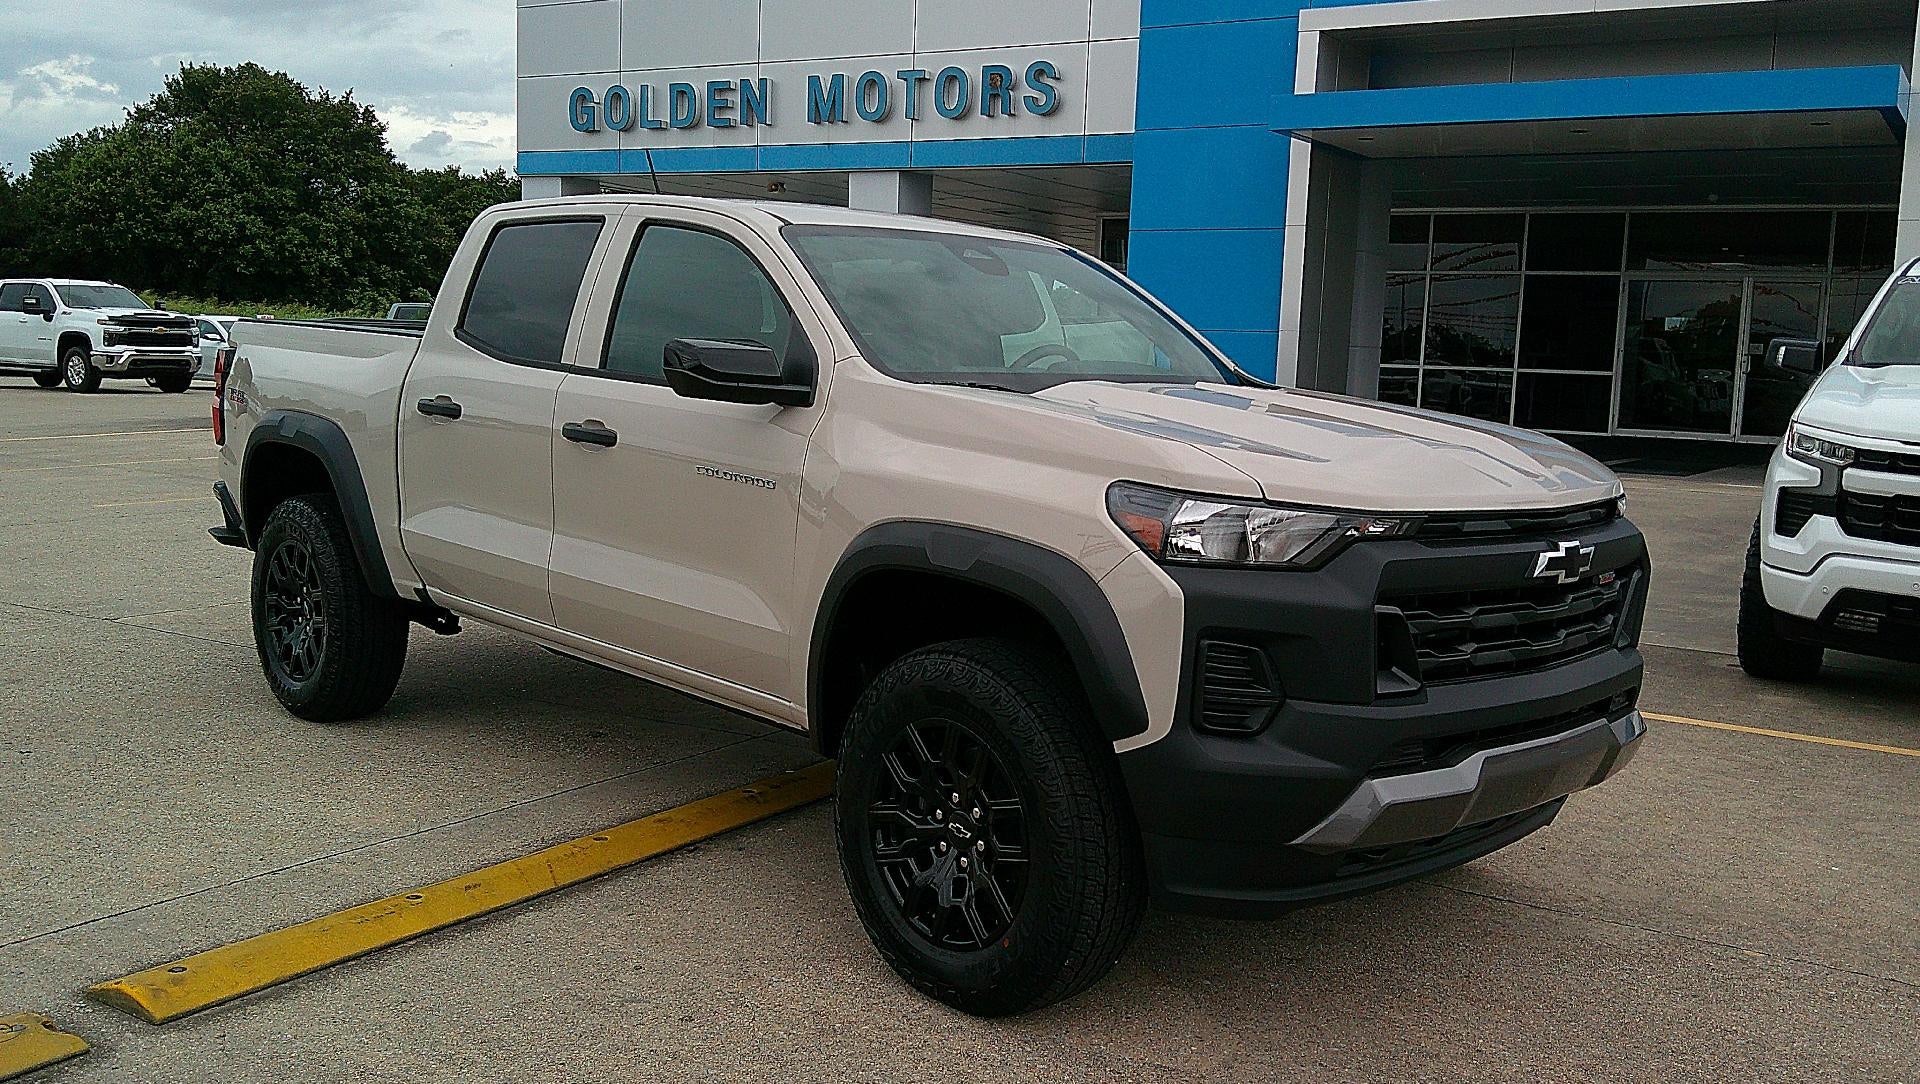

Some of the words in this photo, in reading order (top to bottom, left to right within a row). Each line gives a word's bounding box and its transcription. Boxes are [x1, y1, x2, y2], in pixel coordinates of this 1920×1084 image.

[568, 78, 772, 133] GOLDEN
[806, 61, 1061, 123] MOTORS
[696, 465, 776, 489] COLORADO
